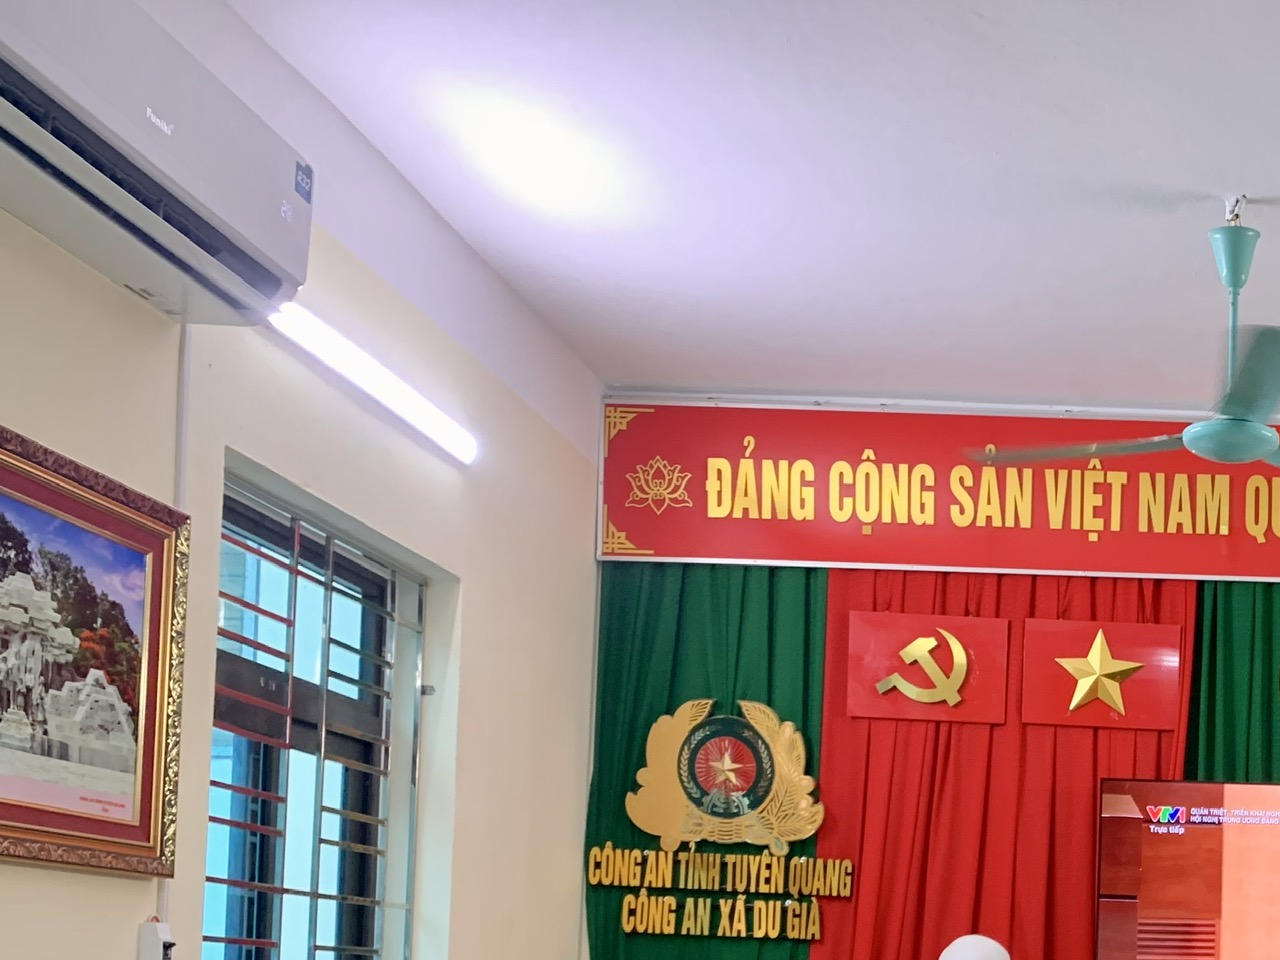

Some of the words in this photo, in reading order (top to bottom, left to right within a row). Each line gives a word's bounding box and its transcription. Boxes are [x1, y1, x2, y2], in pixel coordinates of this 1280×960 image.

[146, 107, 172, 136] Funiki
[297, 171, 311, 191] R32
[705, 435, 816, 521] ĐẢNG
[828, 448, 936, 535] CỘNG
[949, 443, 1034, 529] SẢN
[1044, 457, 1129, 542] VIỆT
[1138, 471, 1231, 536] NAM
[589, 841, 641, 887] CÔNG
[644, 851, 673, 888] AN
[677, 841, 722, 891] TỈNH
[724, 849, 786, 894] TUYÊN
[788, 856, 853, 899] QUANG
[622, 888, 676, 935] CÔNG
[681, 897, 712, 936] AN
[717, 893, 747, 938] XÃ
[753, 899, 782, 939] DU
[786, 896, 821, 941] GIÀ
